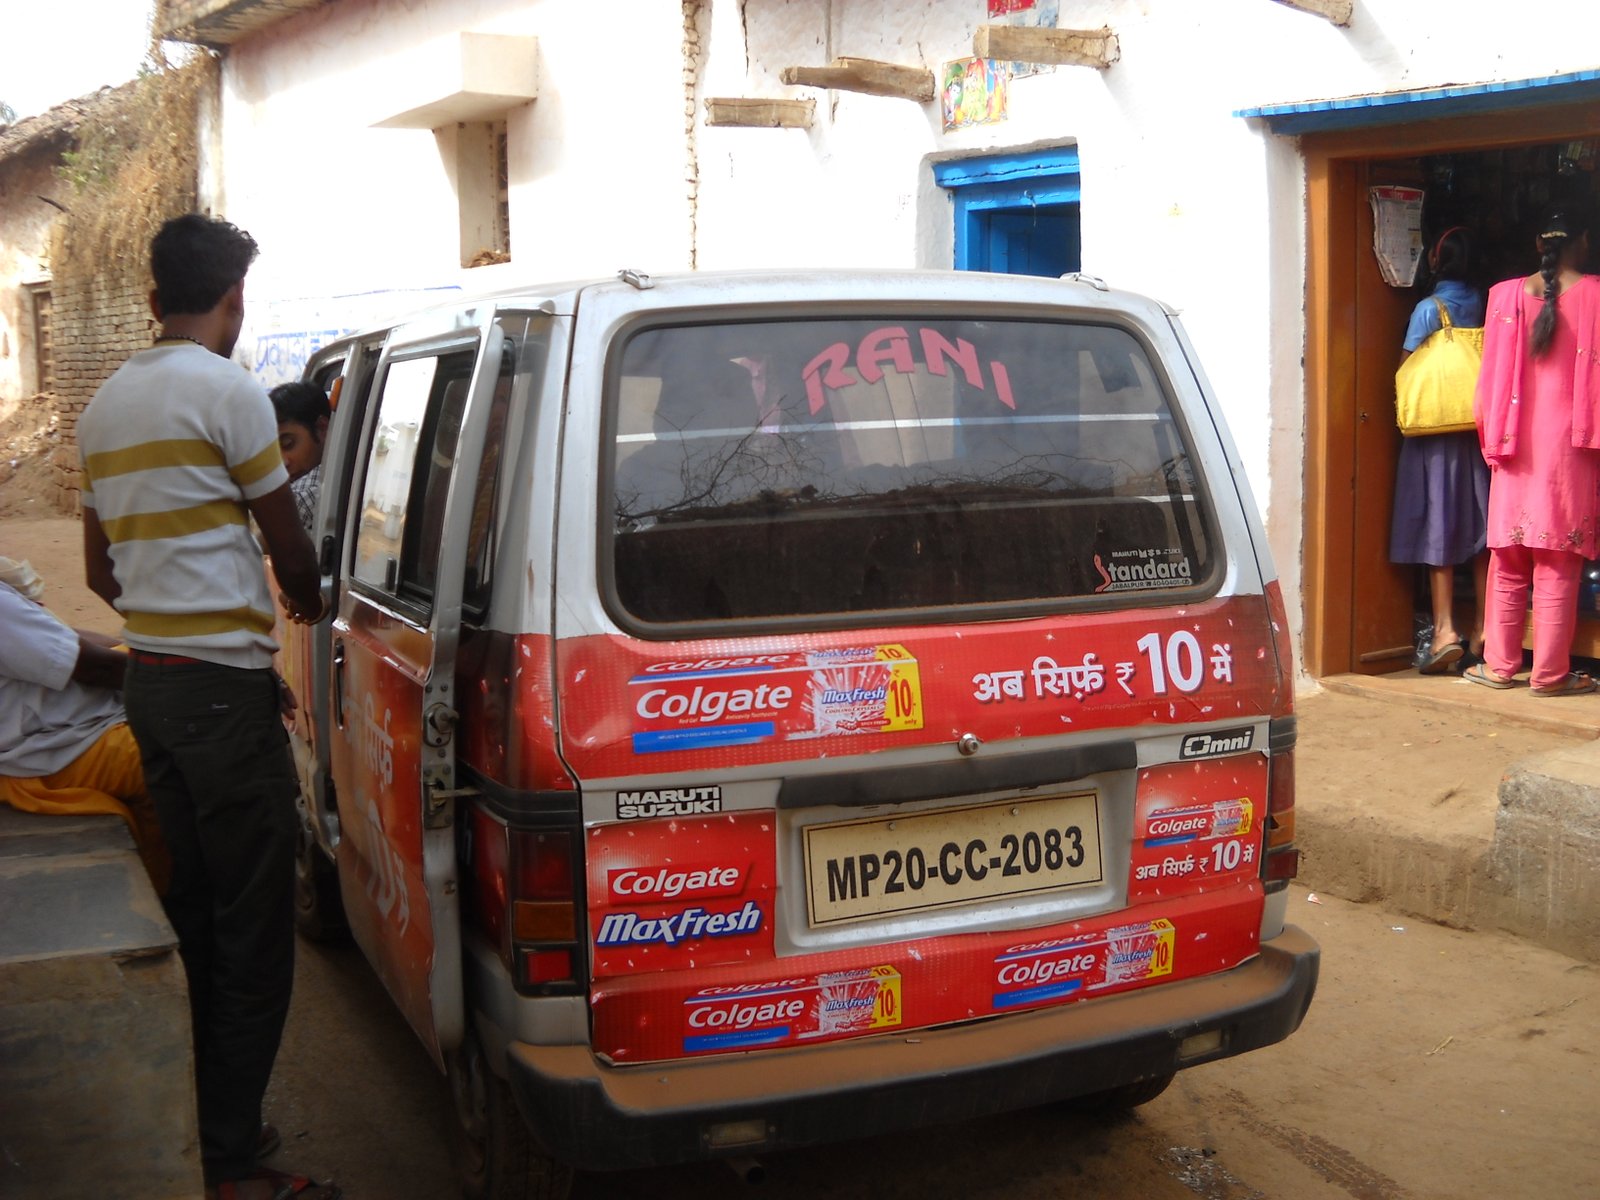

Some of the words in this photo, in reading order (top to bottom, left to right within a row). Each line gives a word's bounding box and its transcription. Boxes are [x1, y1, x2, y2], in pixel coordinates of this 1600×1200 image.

[802, 326, 1016, 416] RANI
[1093, 554, 1191, 593] Standard
[1112, 581, 1145, 590] JABALPUR
[879, 648, 902, 659] 10
[645, 655, 790, 673] Colgate
[972, 669, 1024, 701] अब
[1210, 643, 1233, 684] में
[636, 684, 793, 722] Colgate
[822, 686, 885, 705] MaxFresh
[1183, 731, 1252, 756] Omni
[618, 786, 720, 806] MARUTI
[618, 800, 720, 818] SUZUKI
[1149, 817, 1207, 835] Colgate
[827, 825, 1085, 903] MP20-CC-2083
[1135, 863, 1160, 880] अब
[1211, 839, 1241, 872] 10
[1242, 843, 1255, 863] में
[612, 866, 739, 898] Colgate
[596, 901, 761, 943] MaxFresh
[1153, 920, 1167, 929] 10
[1006, 933, 1097, 953] Colgate
[1111, 948, 1154, 965] MaxFresh
[874, 967, 891, 976] 10
[998, 953, 1096, 985] Colgate
[697, 977, 806, 997] Colgate
[825, 995, 875, 1012] MaxFresh
[688, 999, 805, 1029] Colgate
